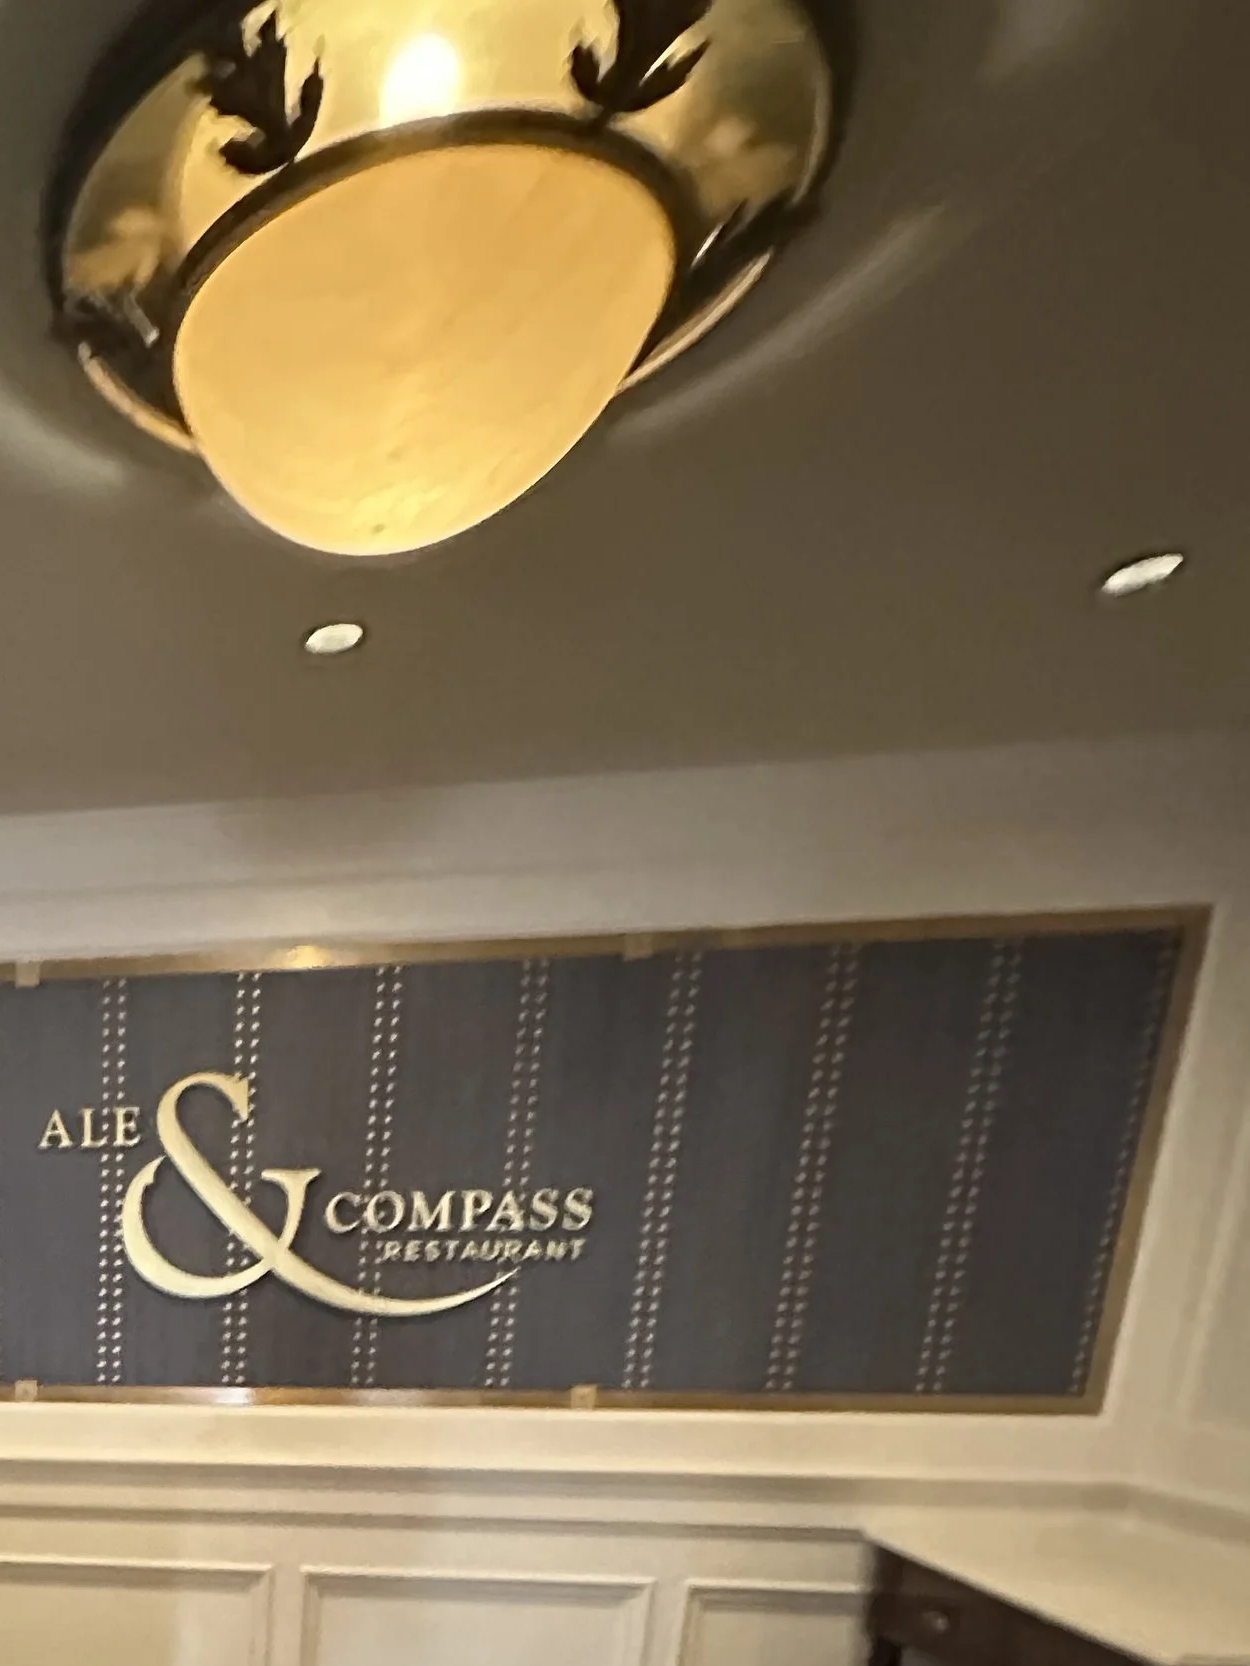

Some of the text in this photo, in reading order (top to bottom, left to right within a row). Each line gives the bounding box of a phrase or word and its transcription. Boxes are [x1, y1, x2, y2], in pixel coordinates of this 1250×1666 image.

[38, 1071, 594, 1317] ALE & COMPASS
[381, 1237, 587, 1263] RESTAURANT
